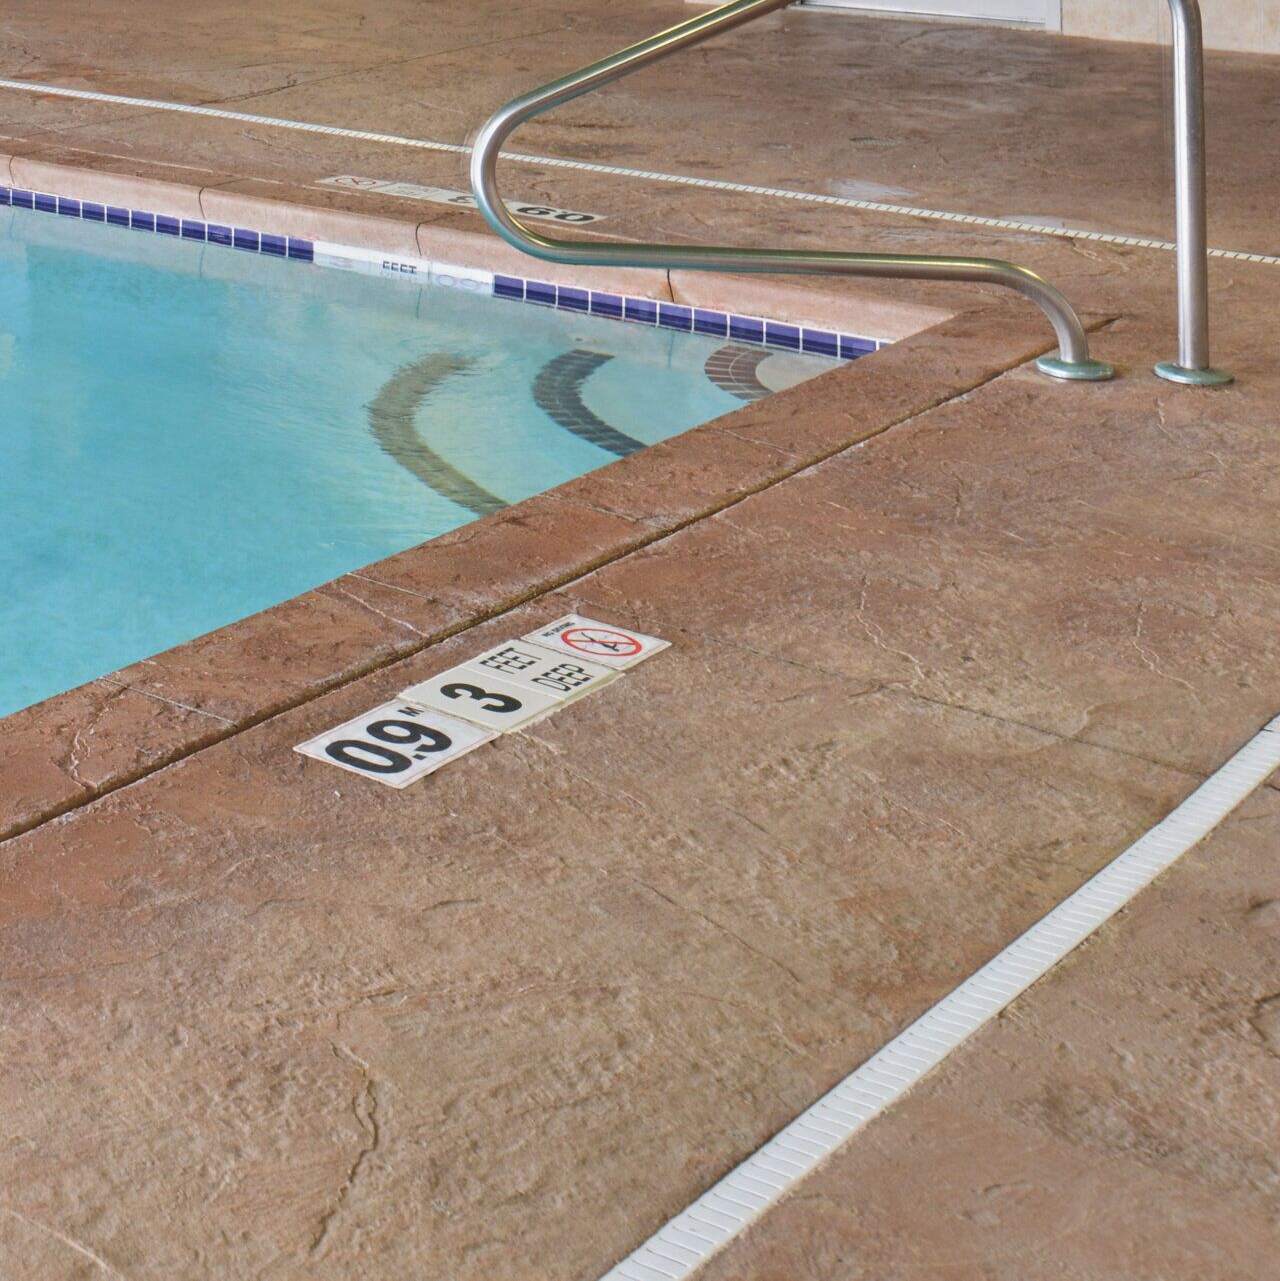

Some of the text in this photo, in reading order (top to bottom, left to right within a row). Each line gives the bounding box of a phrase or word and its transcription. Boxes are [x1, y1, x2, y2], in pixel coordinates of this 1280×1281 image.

[479, 647, 543, 676] FEET
[531, 663, 595, 692] DEEP
[440, 682, 523, 714] 3
[325, 705, 453, 774] 0.9 M
